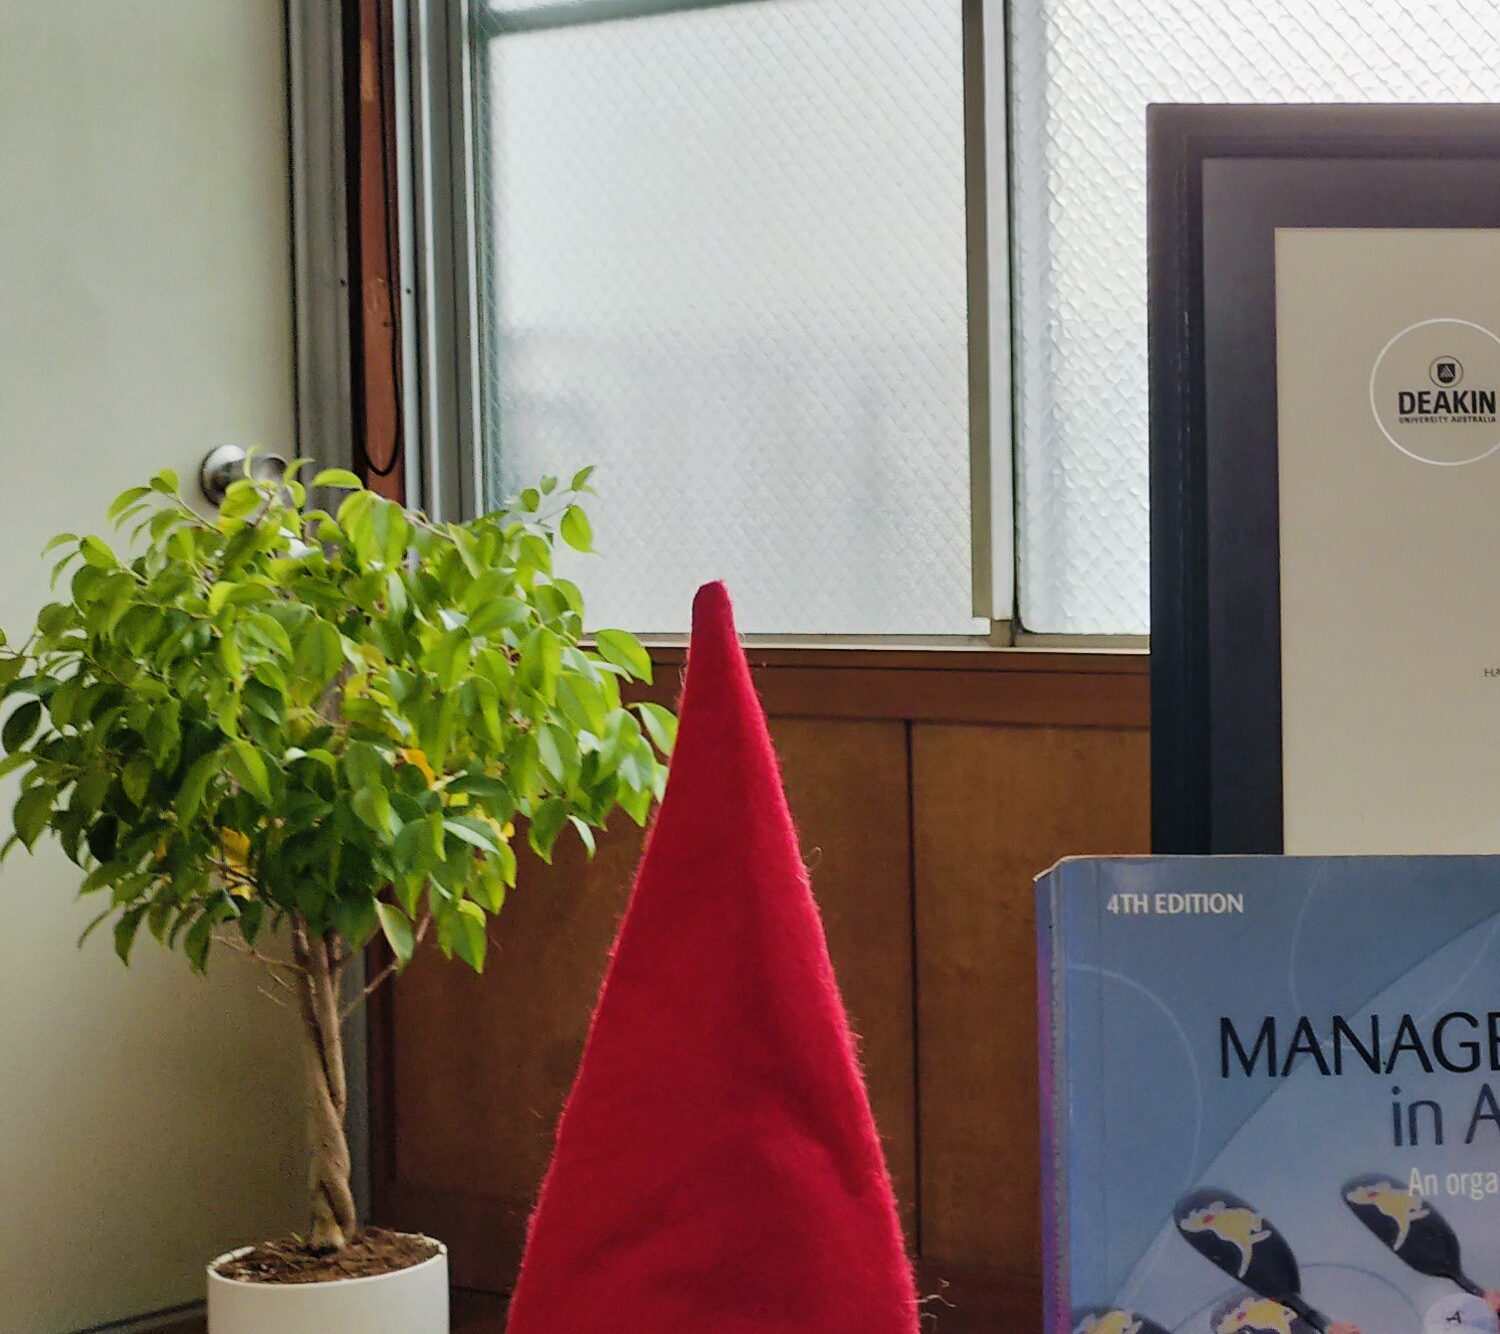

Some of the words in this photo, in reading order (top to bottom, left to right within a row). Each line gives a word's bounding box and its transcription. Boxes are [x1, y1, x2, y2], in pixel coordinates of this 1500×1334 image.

[1398, 390, 1496, 415] DEAKIN
[1399, 416, 1449, 424] UNIVERSITY
[1451, 415, 1496, 423] AUSTRALIA
[1107, 893, 1149, 914] 4TH
[1155, 893, 1244, 914] EDITION
[1391, 1086, 1443, 1147] in
[1406, 1167, 1439, 1197] An
